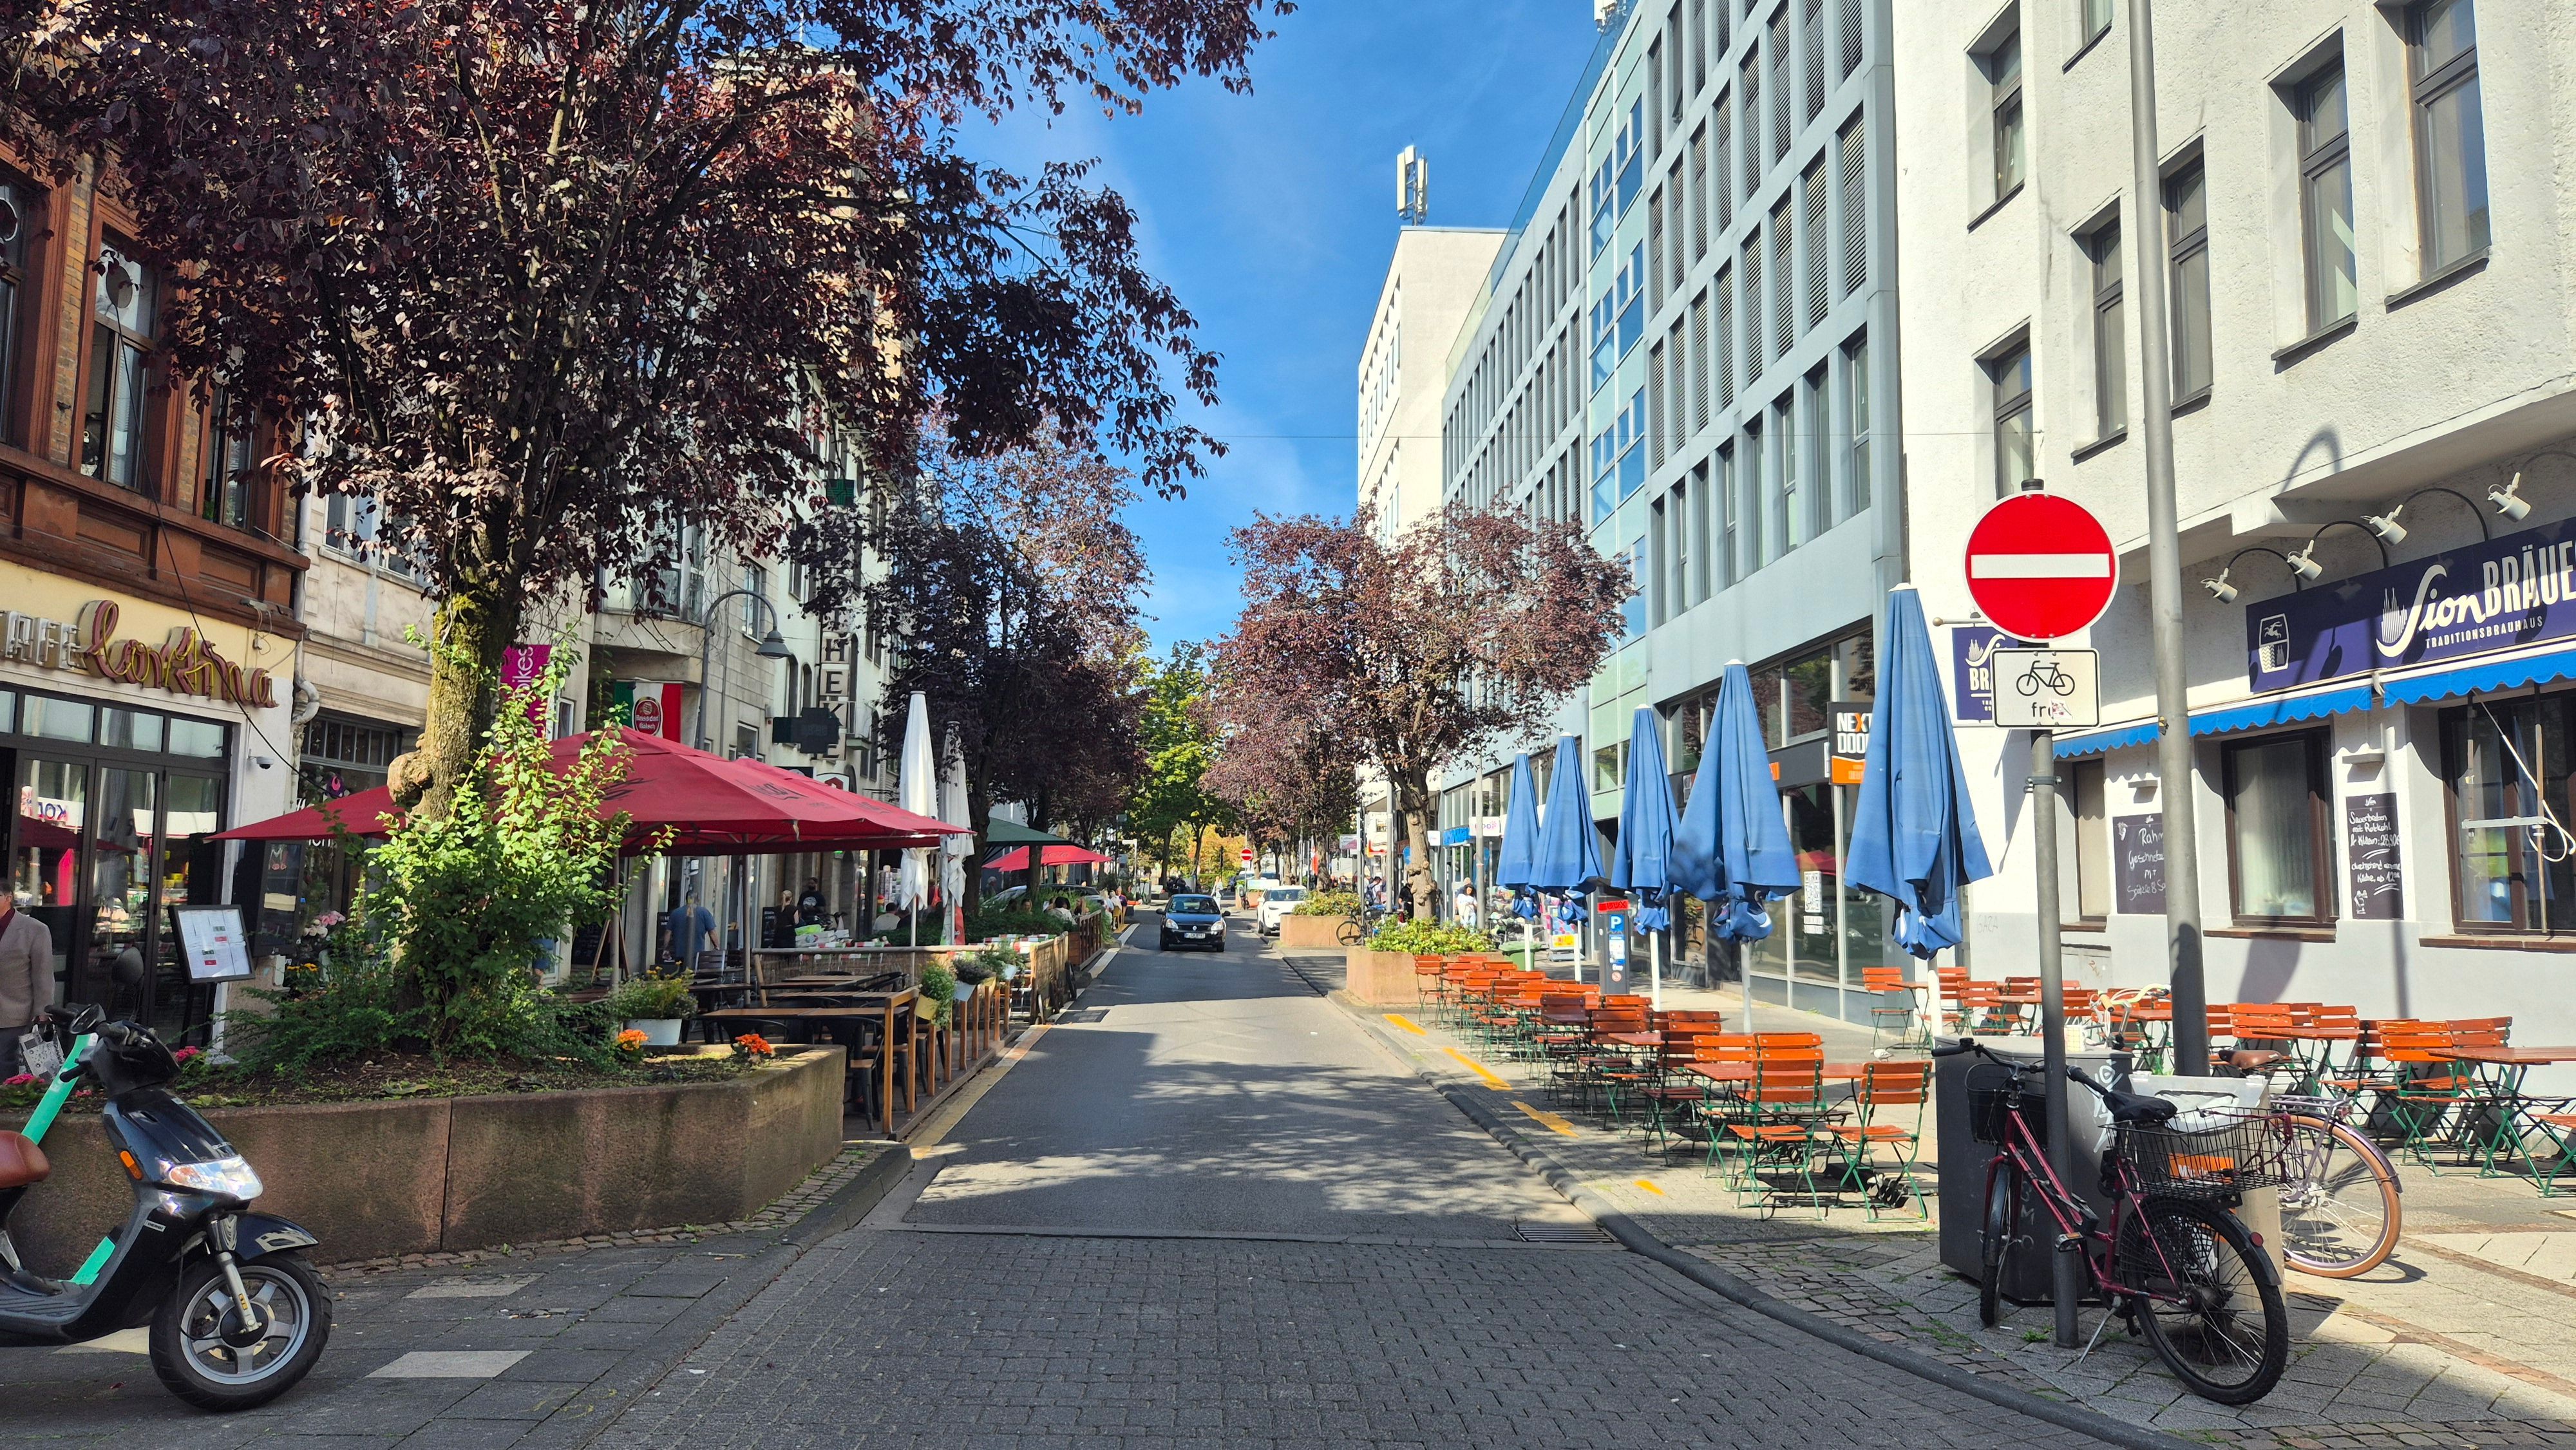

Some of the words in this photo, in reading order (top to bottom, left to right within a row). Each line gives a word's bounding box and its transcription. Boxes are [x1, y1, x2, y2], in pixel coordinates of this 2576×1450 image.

[2483, 539, 2576, 618] BRÄUE
[2425, 615, 2543, 649] TRADITIONSBRAUHAUS
[1837, 733, 1870, 754] DOO
[1611, 916, 1622, 929] P
